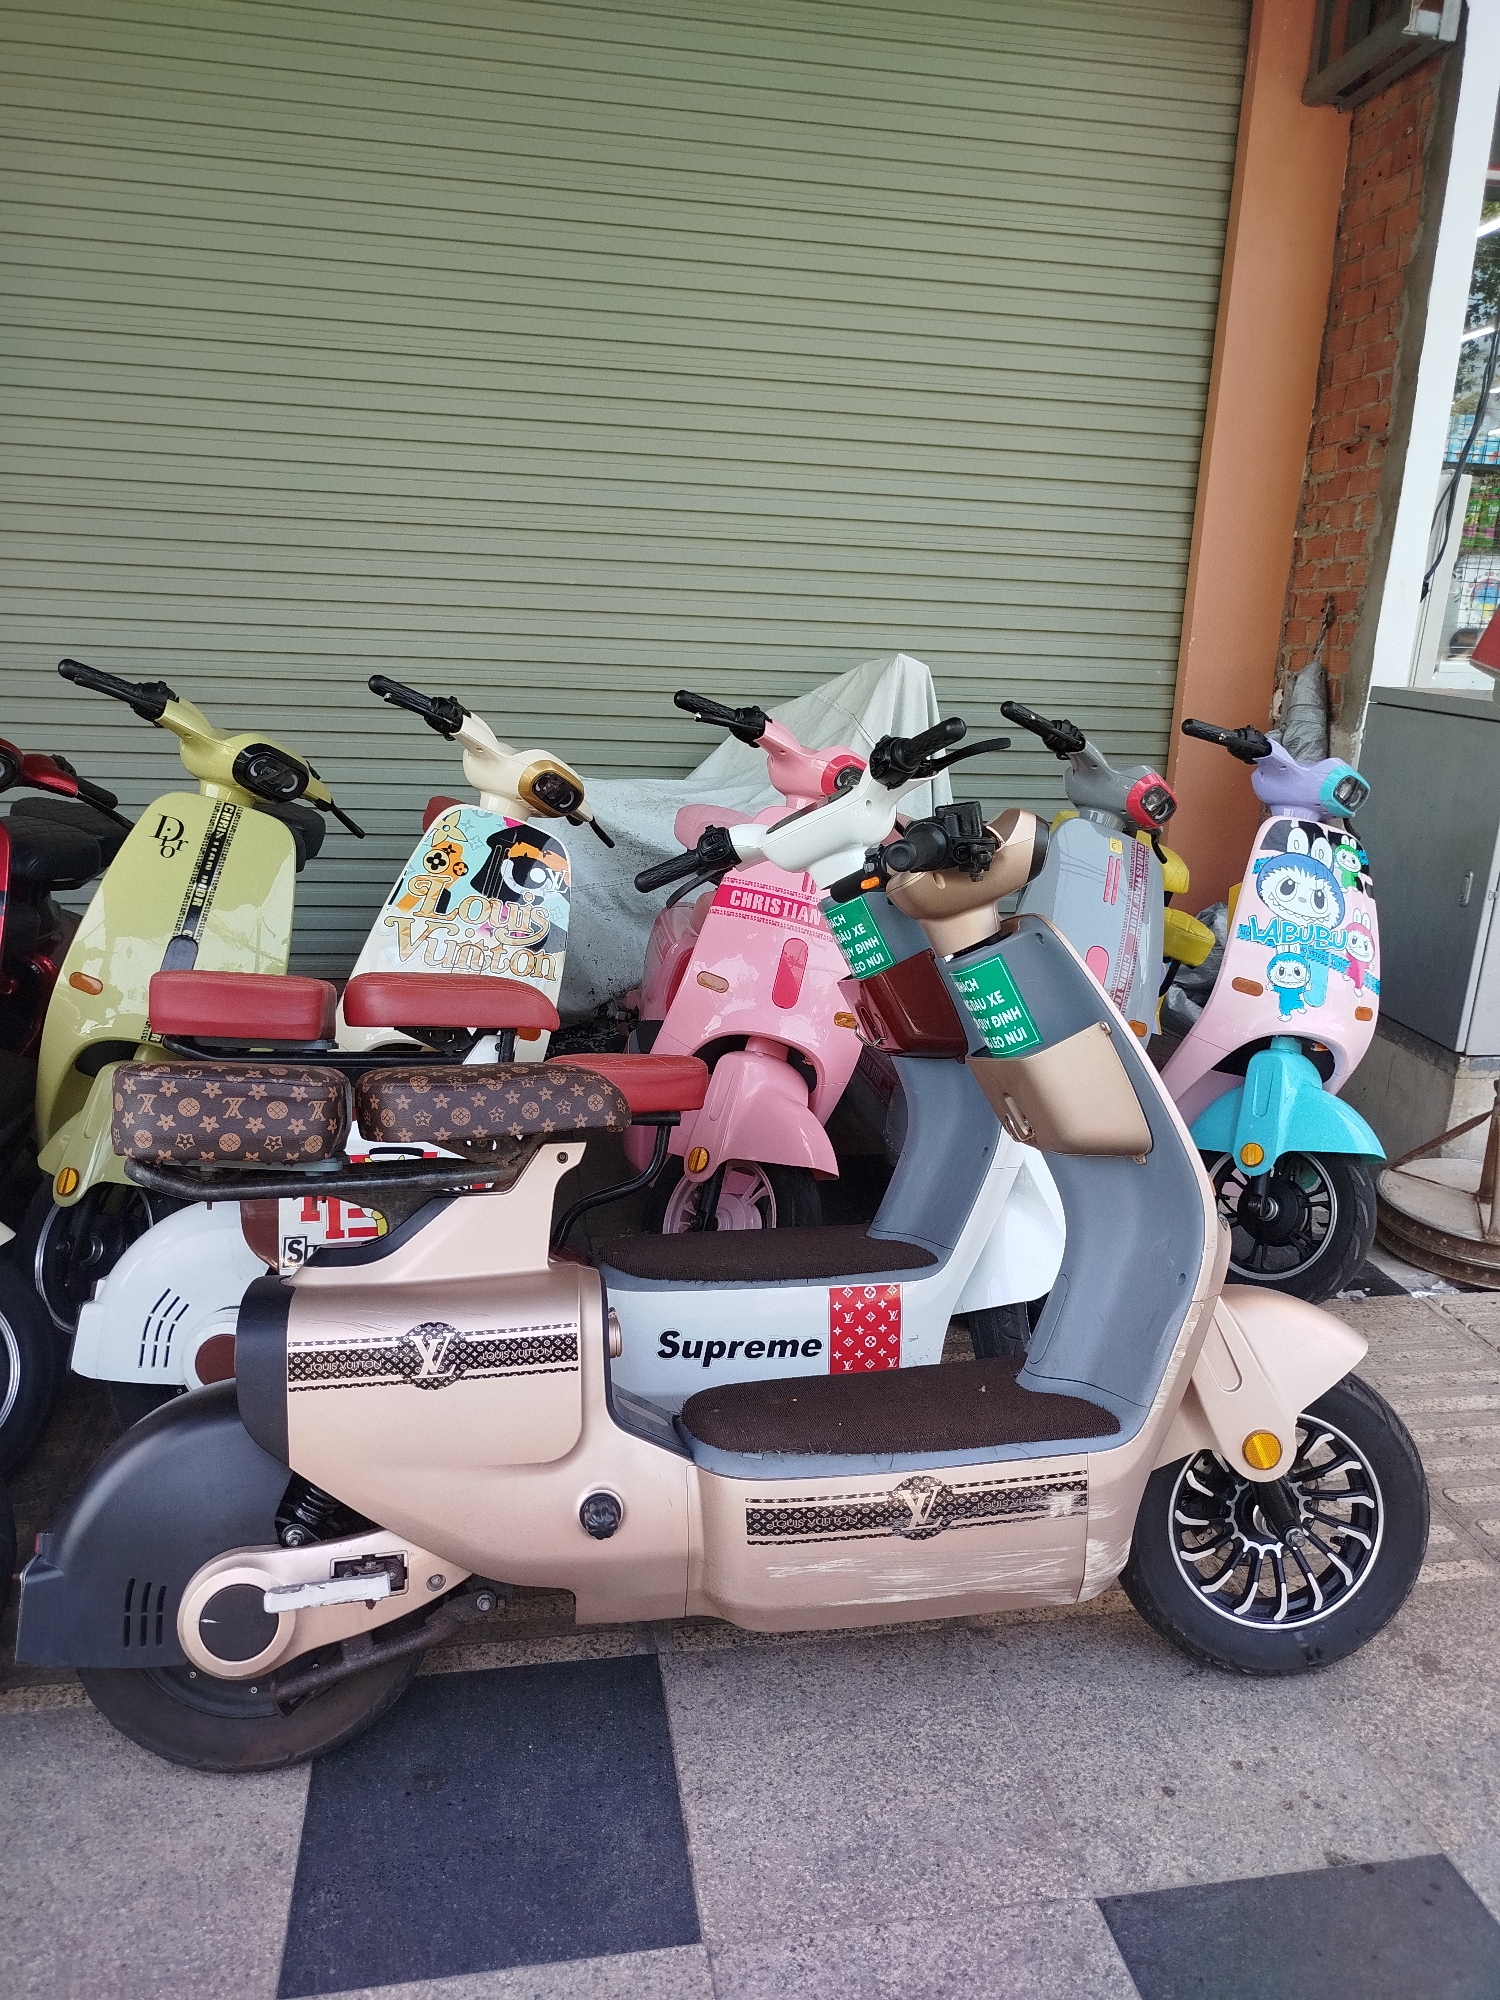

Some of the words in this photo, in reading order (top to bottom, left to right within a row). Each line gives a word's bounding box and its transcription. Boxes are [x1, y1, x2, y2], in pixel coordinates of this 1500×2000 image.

[149, 813, 189, 859] Dior
[407, 874, 550, 947] Louis
[729, 889, 823, 927] CHRISTIAN
[851, 922, 867, 938] XE
[854, 935, 880, 955] ĐỊNH
[1248, 914, 1348, 951] LABUBU
[384, 915, 557, 982] Vuitton
[865, 951, 885, 969] NÚI
[986, 989, 1006, 1008] XE
[990, 1005, 1023, 1029] ĐỊNH
[1003, 1025, 1029, 1046] NÚI
[657, 1329, 823, 1369] Supreme
